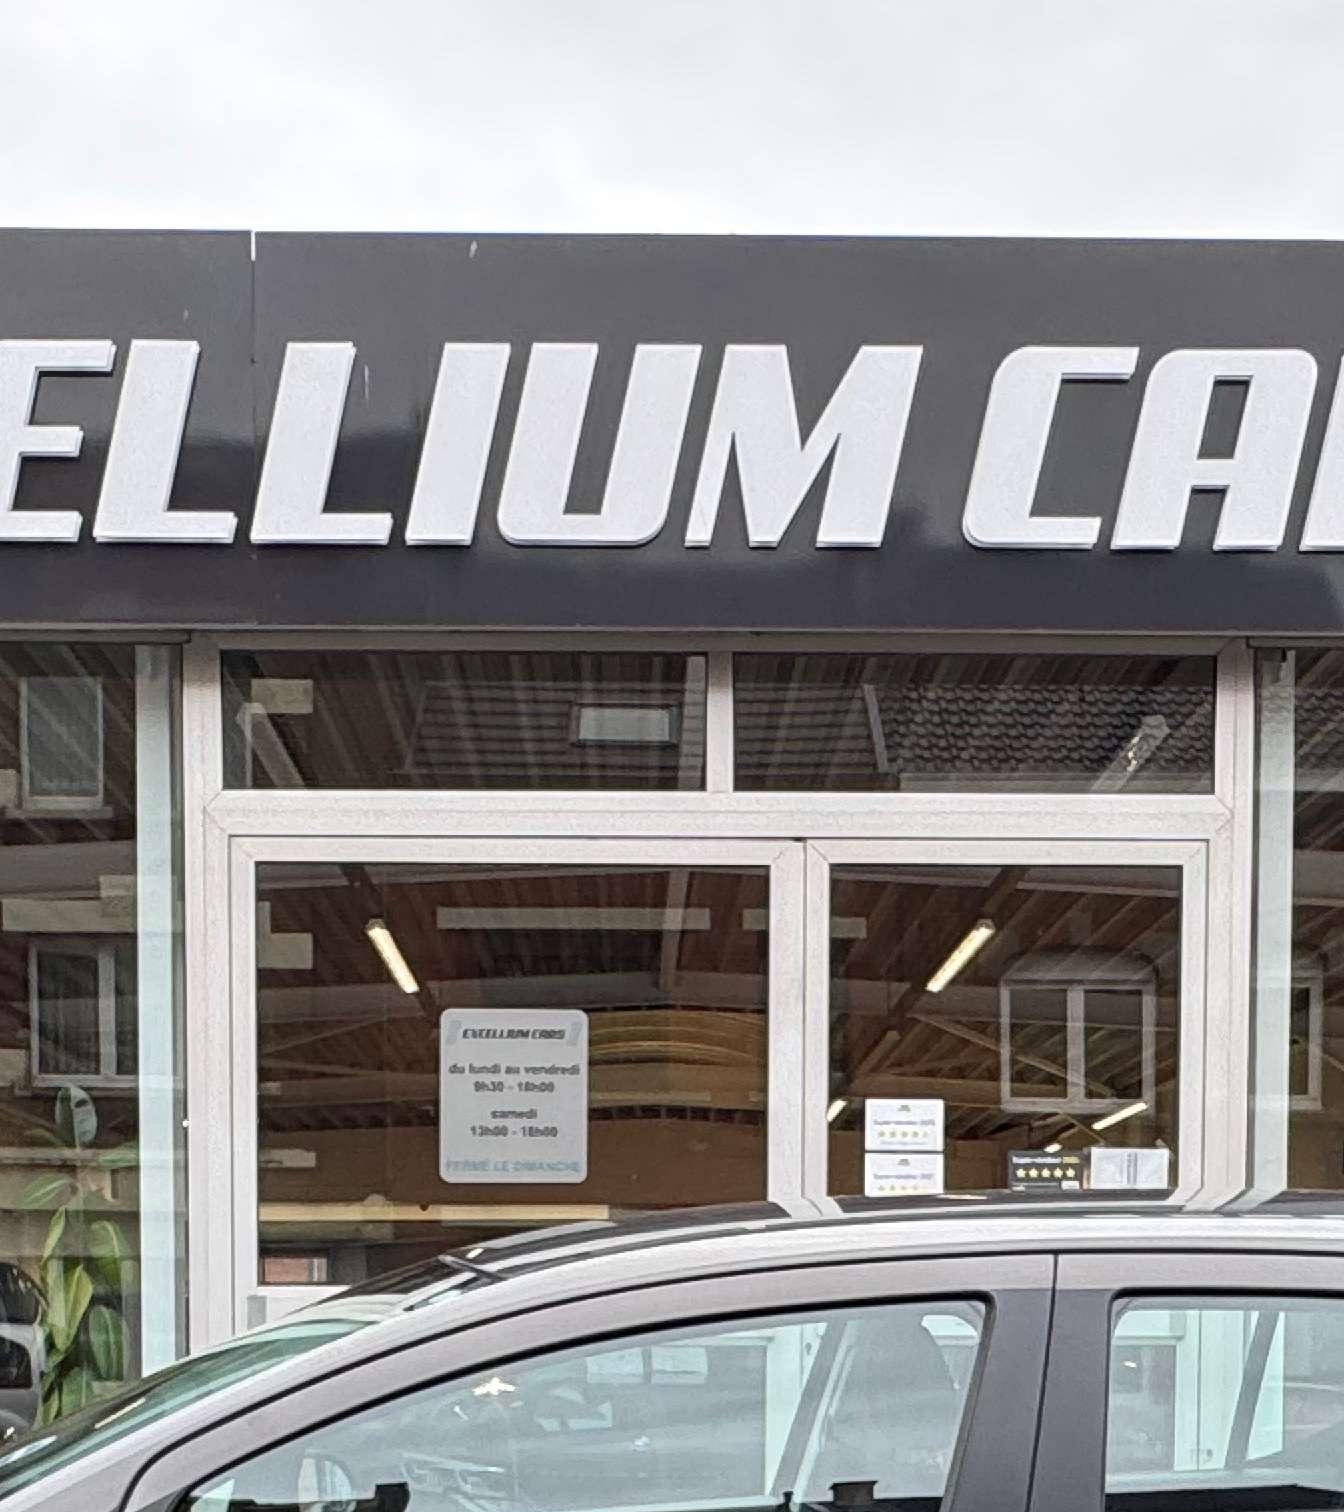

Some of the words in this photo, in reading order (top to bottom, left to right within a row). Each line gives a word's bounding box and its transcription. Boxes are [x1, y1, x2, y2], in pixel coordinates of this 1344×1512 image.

[462, 1028, 530, 1040] EXCELLIUM
[531, 1029, 565, 1040] CARS
[448, 1063, 465, 1075] du
[468, 1063, 501, 1075] lundi
[505, 1065, 520, 1075] au
[524, 1063, 580, 1076] vendredi
[490, 1108, 537, 1119] samedi
